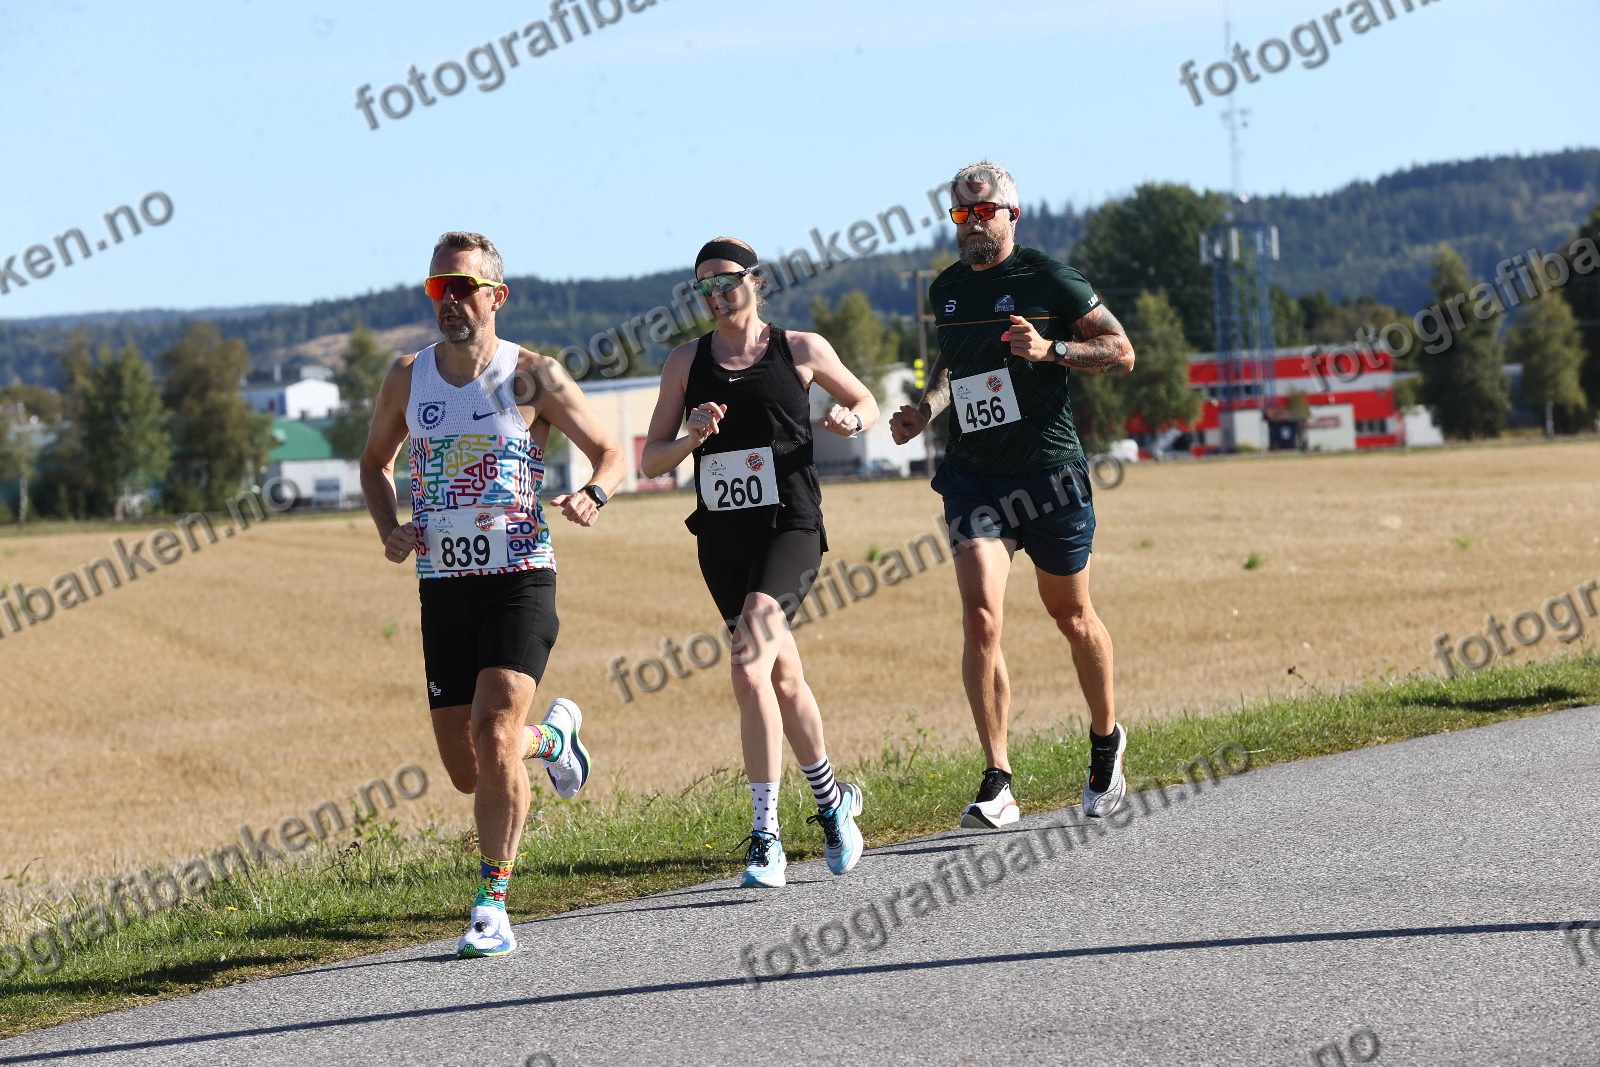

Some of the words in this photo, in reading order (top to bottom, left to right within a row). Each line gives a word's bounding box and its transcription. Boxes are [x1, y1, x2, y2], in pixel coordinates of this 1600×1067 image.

[965, 395, 1006, 429] 456
[714, 474, 763, 509] 260
[440, 534, 491, 568] 839
